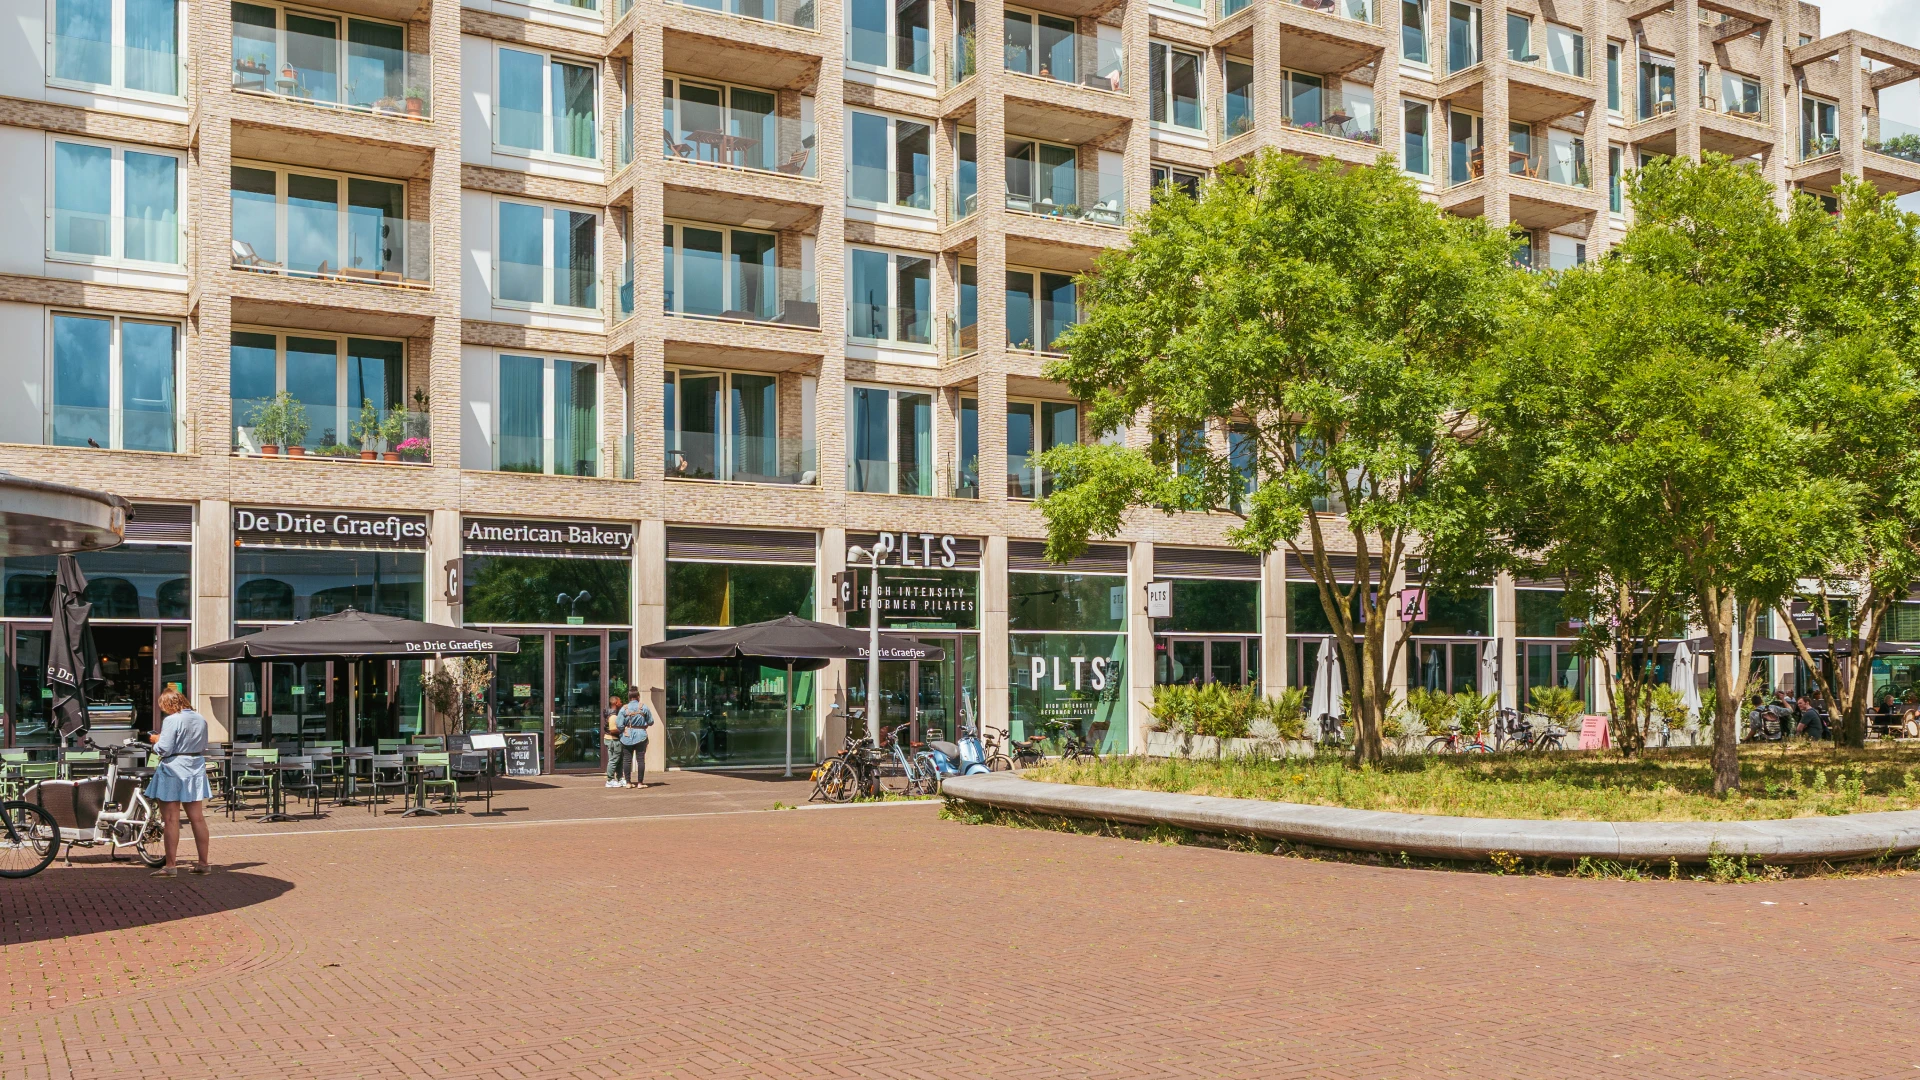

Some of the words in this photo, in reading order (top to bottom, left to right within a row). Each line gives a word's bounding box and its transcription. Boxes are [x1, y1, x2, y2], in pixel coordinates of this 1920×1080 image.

[238, 511, 270, 532] De
[276, 512, 326, 533] Drie
[333, 515, 426, 541] Graefjes
[468, 522, 563, 543] American
[568, 526, 633, 550] Bakery
[880, 532, 956, 567] PLTS
[449, 568, 457, 596] G
[841, 582, 850, 602] G
[862, 586, 891, 596] HGH
[899, 586, 964, 598] INTENSITY
[861, 599, 916, 610] EORMER
[924, 601, 974, 611] PILATES
[405, 642, 421, 651] De
[423, 641, 447, 651] Drie
[448, 640, 493, 651] Graefjes
[858, 648, 870, 657] De
[878, 648, 890, 657] rie
[891, 648, 926, 658] Graefjes
[56, 668, 76, 684] Dri
[244, 681, 255, 691] 111
[511, 751, 530, 760] OPEN
